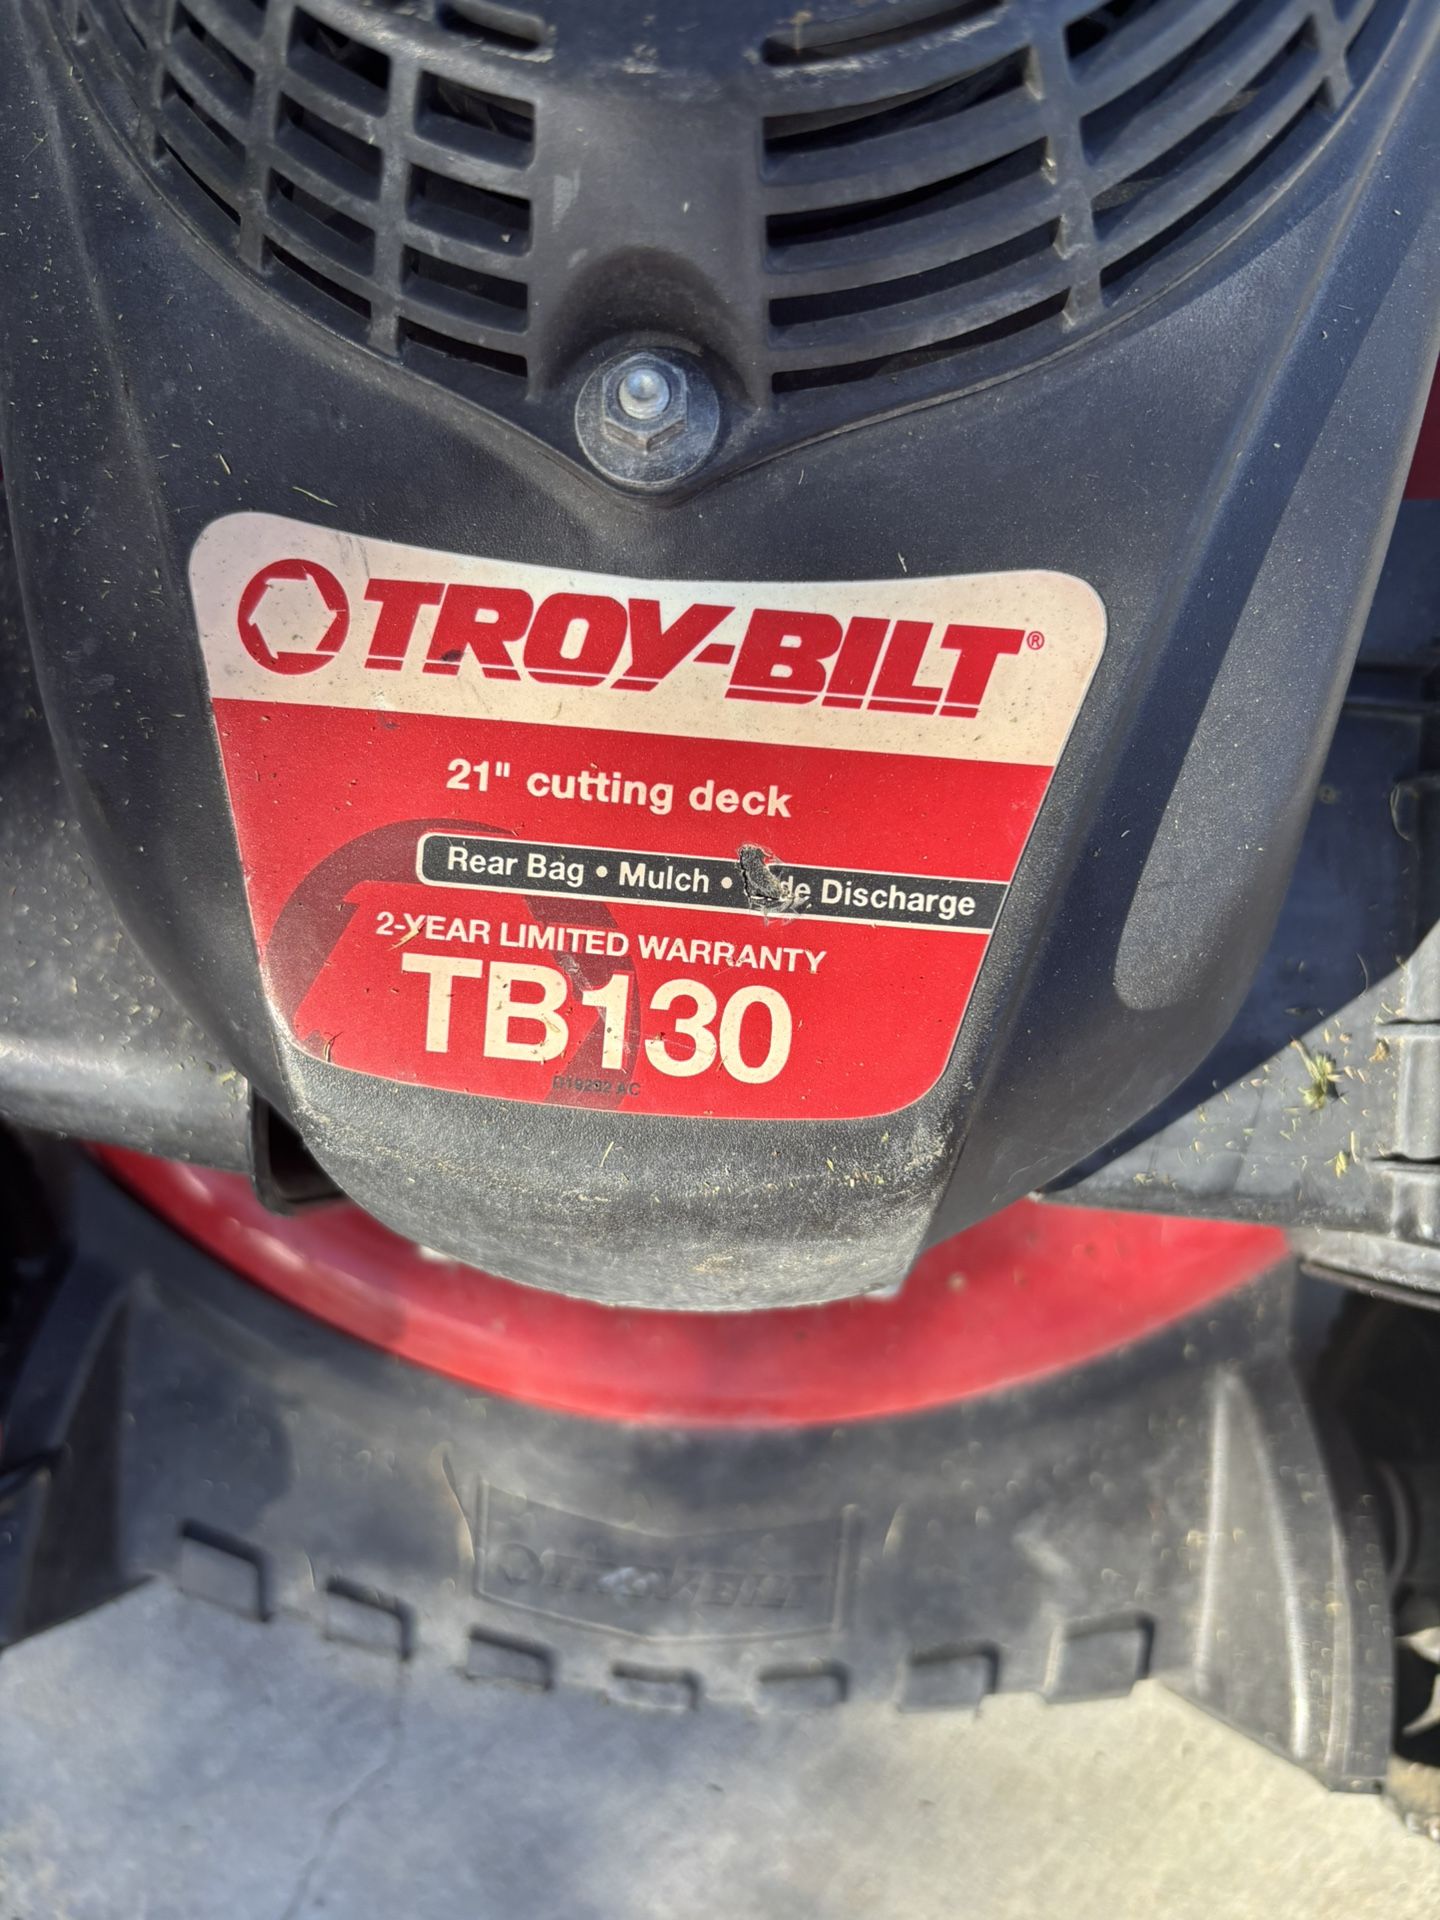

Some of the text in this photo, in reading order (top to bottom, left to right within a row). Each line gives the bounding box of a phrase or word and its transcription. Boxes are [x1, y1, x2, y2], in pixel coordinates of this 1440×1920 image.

[446, 759, 792, 818] 21" cutting deck
[448, 845, 517, 874] Rear
[527, 853, 584, 888] Bag
[619, 861, 709, 893] Mulch
[821, 878, 976, 920] Discharge
[376, 911, 827, 974] 2-YEAR LIMITED WARRANTY
[401, 952, 793, 1085] TB130
